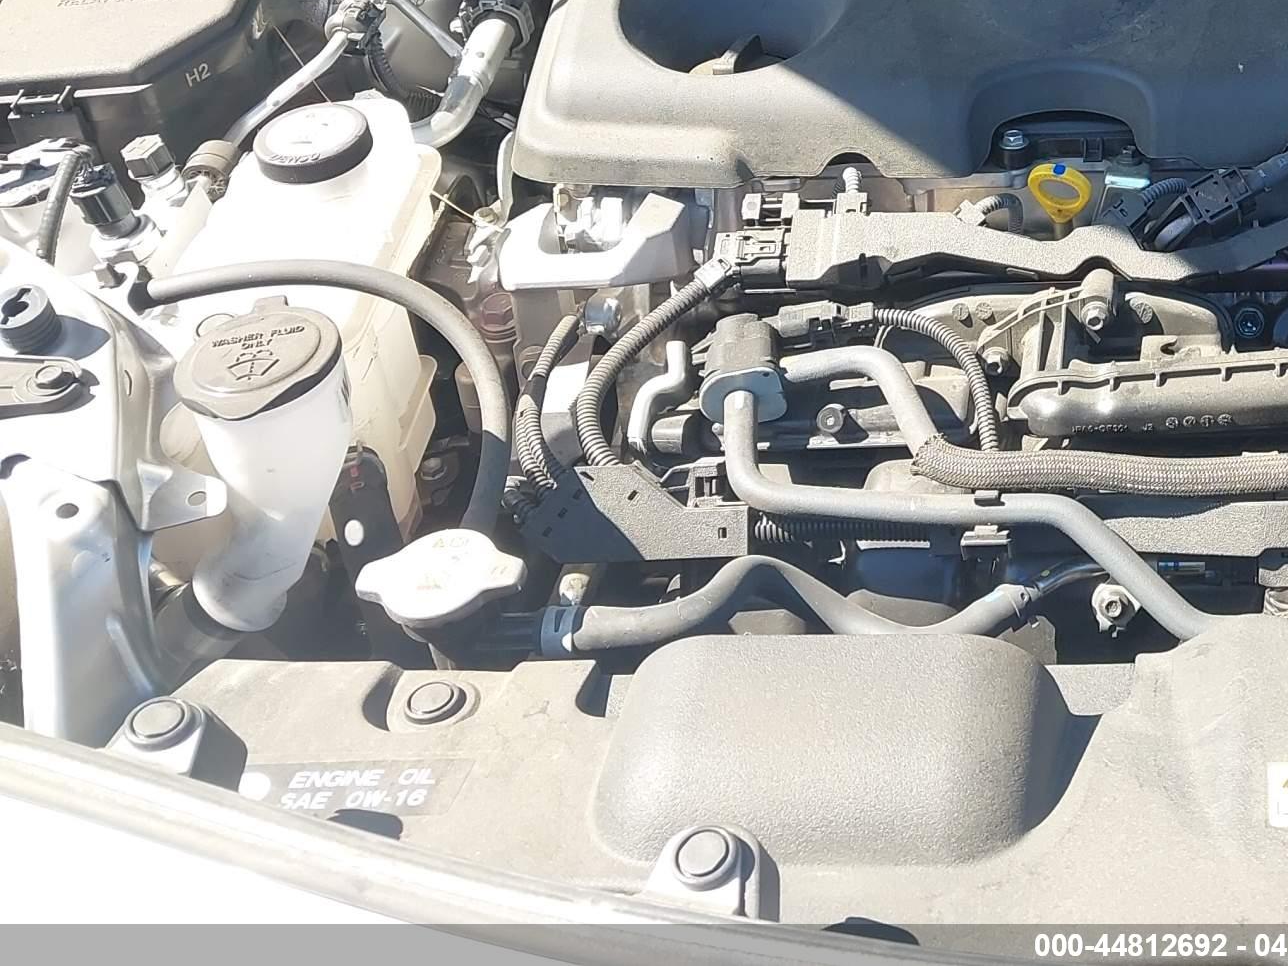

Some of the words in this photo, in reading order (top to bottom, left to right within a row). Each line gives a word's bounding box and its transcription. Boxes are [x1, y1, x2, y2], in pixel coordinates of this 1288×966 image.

[185, 63, 211, 87] H2
[212, 332, 264, 348] WASHER
[271, 325, 305, 338] FLUID
[241, 338, 273, 351] ONLY
[288, 769, 385, 789] ENGINE
[398, 767, 435, 786] OIL
[280, 791, 333, 810] SAE
[345, 788, 428, 808] 0W-16
